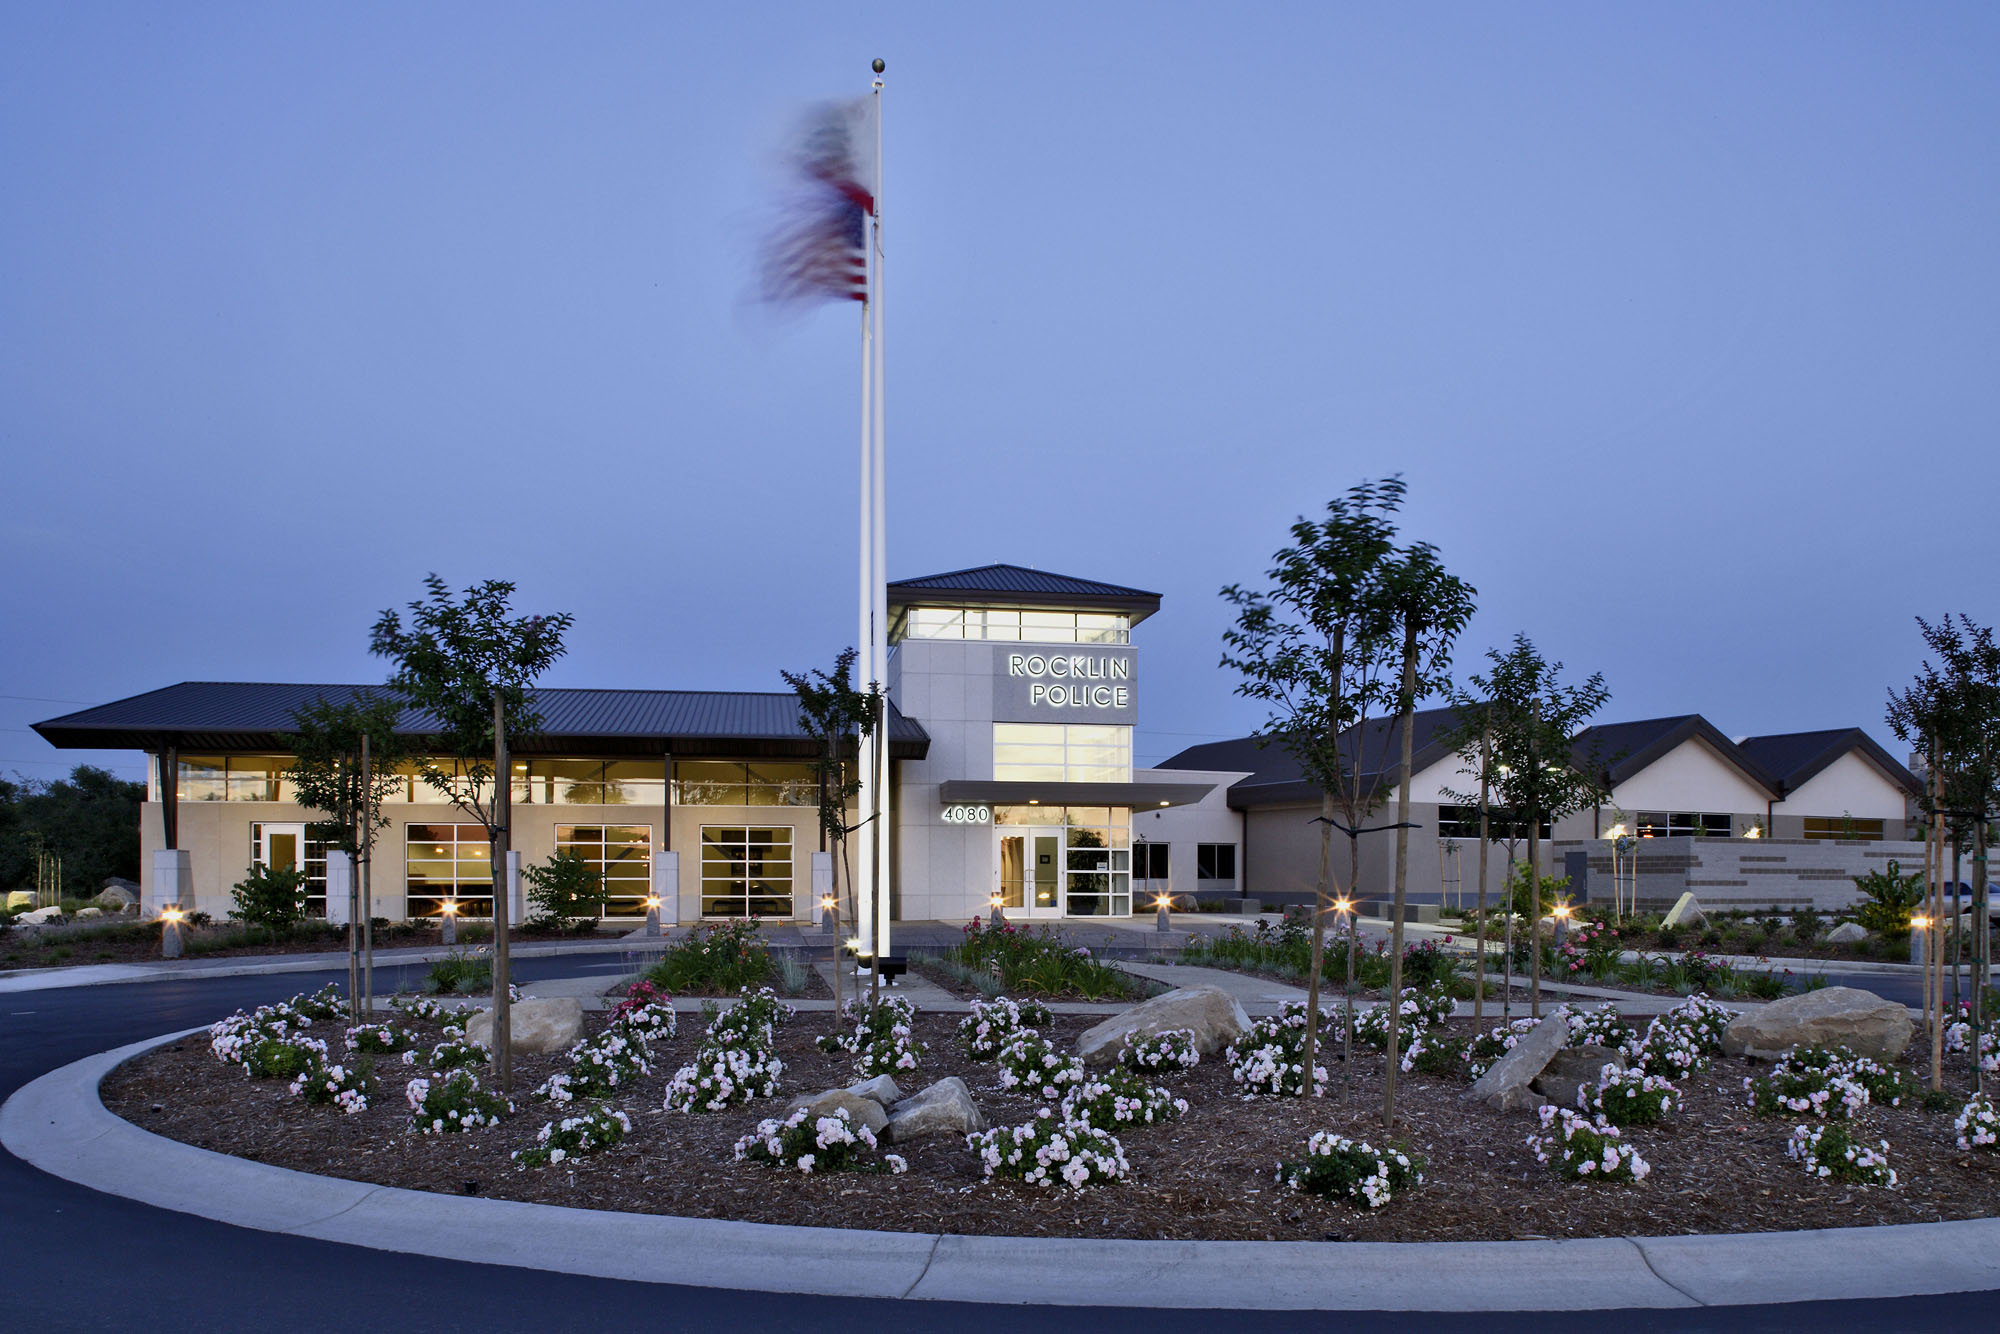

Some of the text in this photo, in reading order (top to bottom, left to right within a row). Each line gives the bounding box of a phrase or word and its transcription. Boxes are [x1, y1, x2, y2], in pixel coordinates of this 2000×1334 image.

[1011, 655, 1128, 678] ROCKLIN
[1032, 685, 1128, 706] POLICE
[943, 807, 989, 821] 4080
